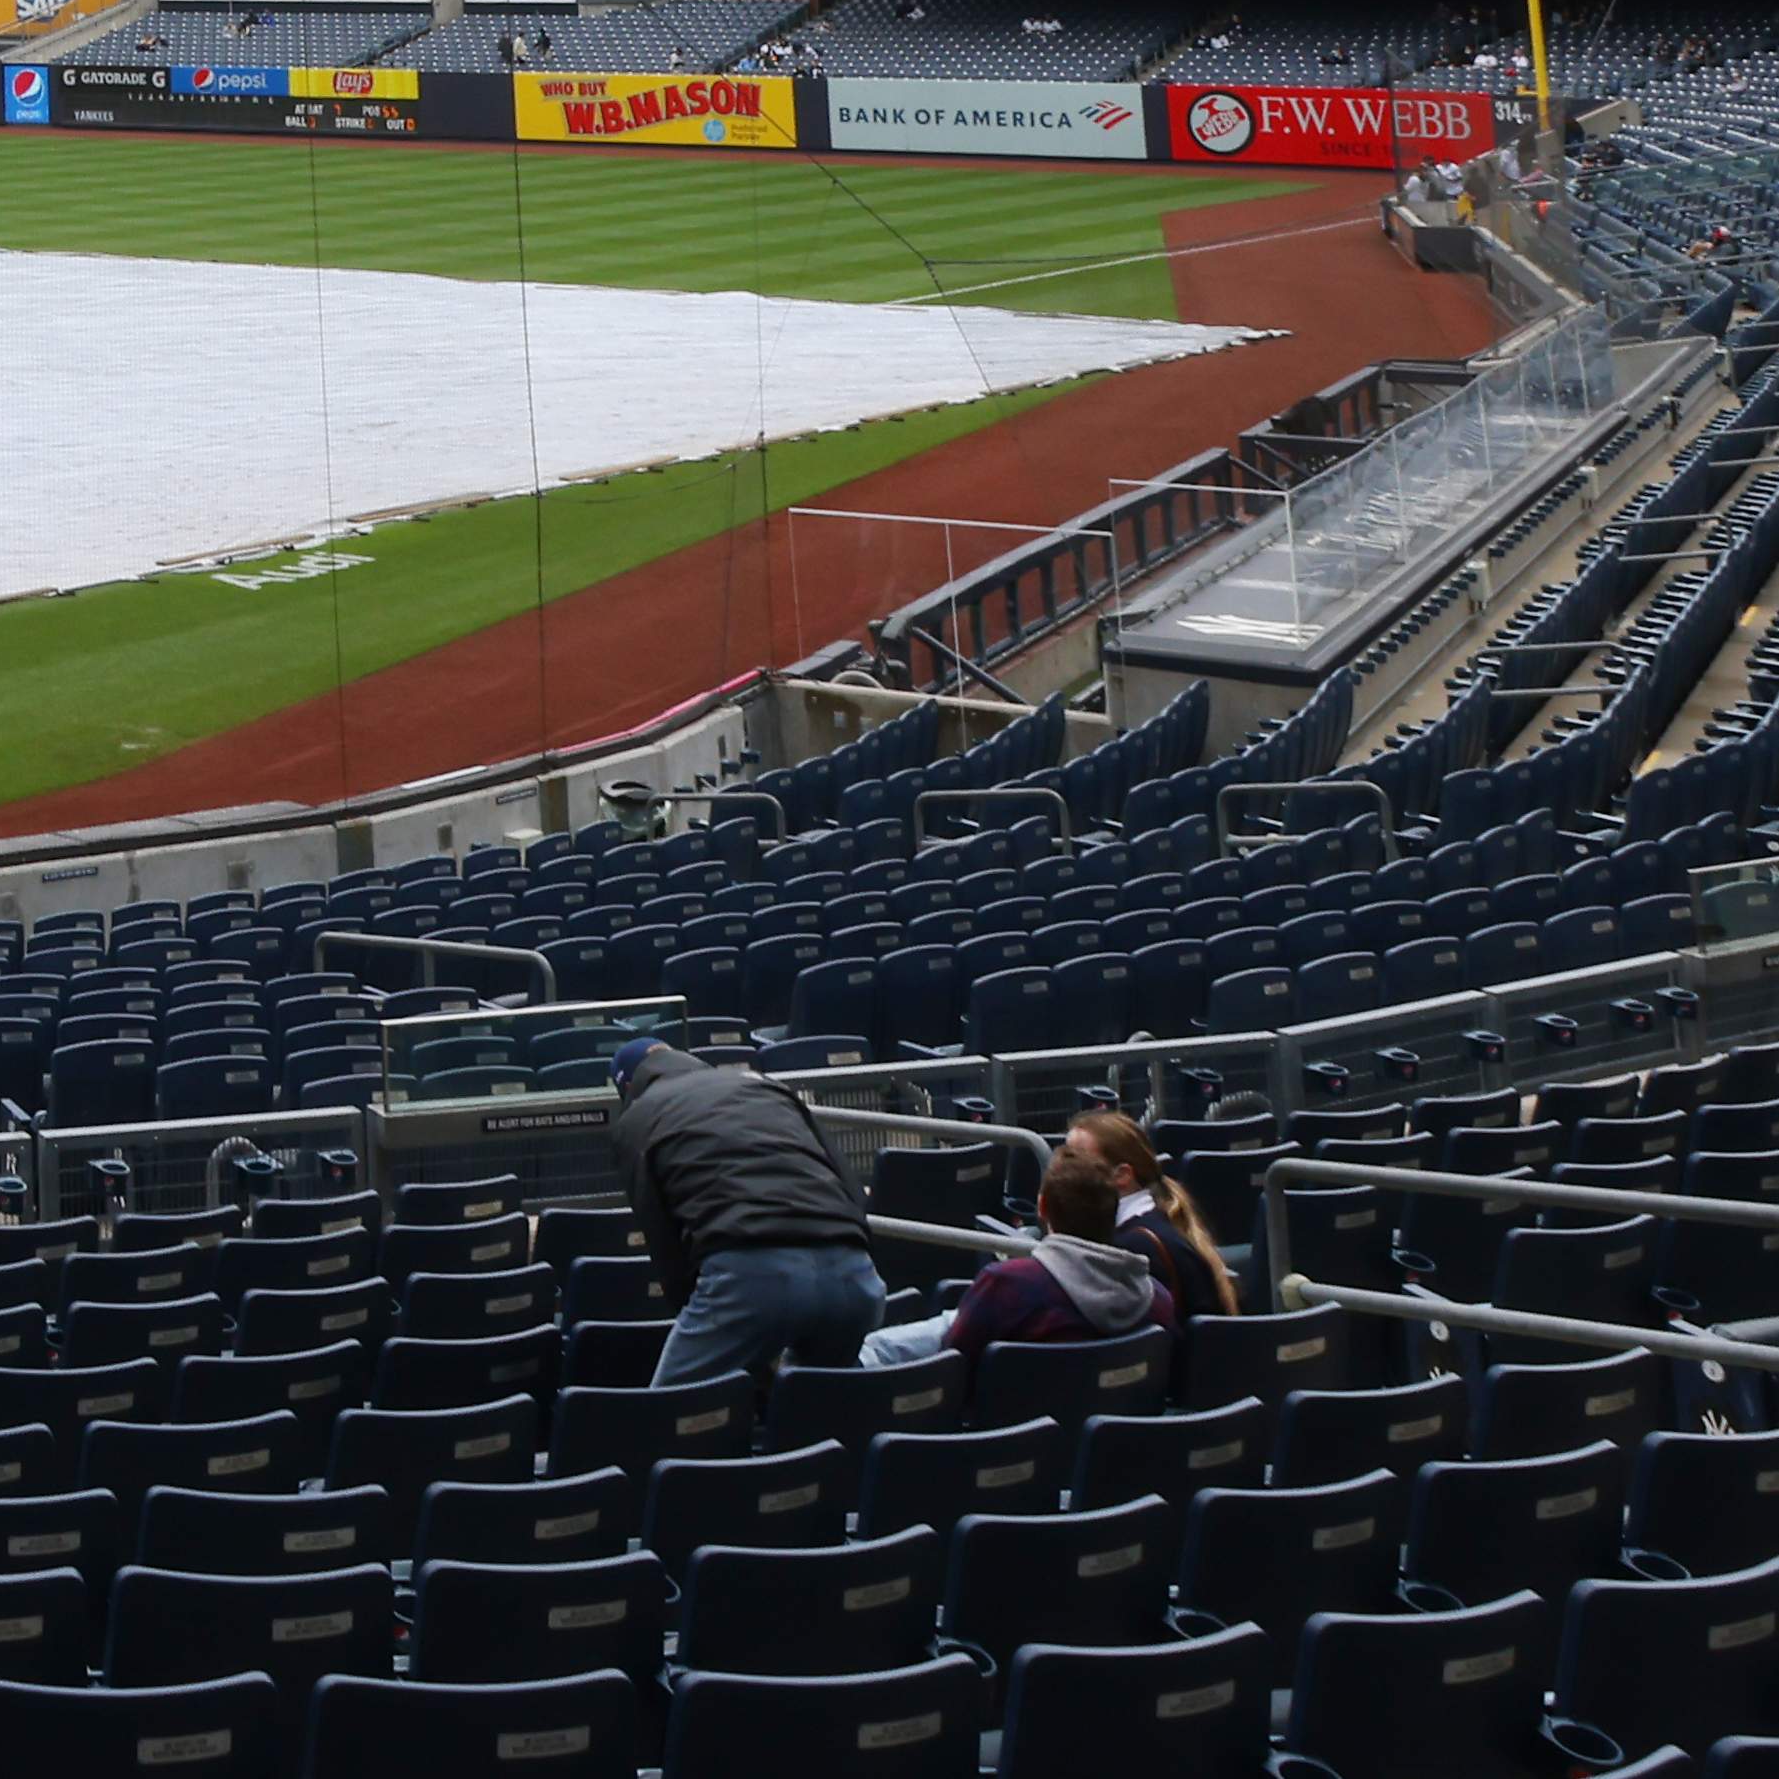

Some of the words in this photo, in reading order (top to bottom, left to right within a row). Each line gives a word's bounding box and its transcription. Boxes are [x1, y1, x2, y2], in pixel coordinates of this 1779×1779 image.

[63, 70, 76, 86] G
[81, 71, 147, 86] GATORADE
[152, 71, 166, 88] G
[218, 72, 268, 91] pepsi
[540, 81, 574, 97] WHO
[577, 81, 607, 96] BUT
[73, 110, 114, 123] YANKEES
[285, 116, 307, 128] BALL
[335, 117, 366, 129] STRIKE
[838, 107, 907, 125] BANK
[914, 108, 946, 125] OF
[953, 109, 1073, 129] AMERICA
[1259, 96, 1335, 136] F.W.
[1341, 98, 1472, 140] WEBB
[1321, 142, 1371, 157] SINCE
[211, 550, 377, 591] Audi
